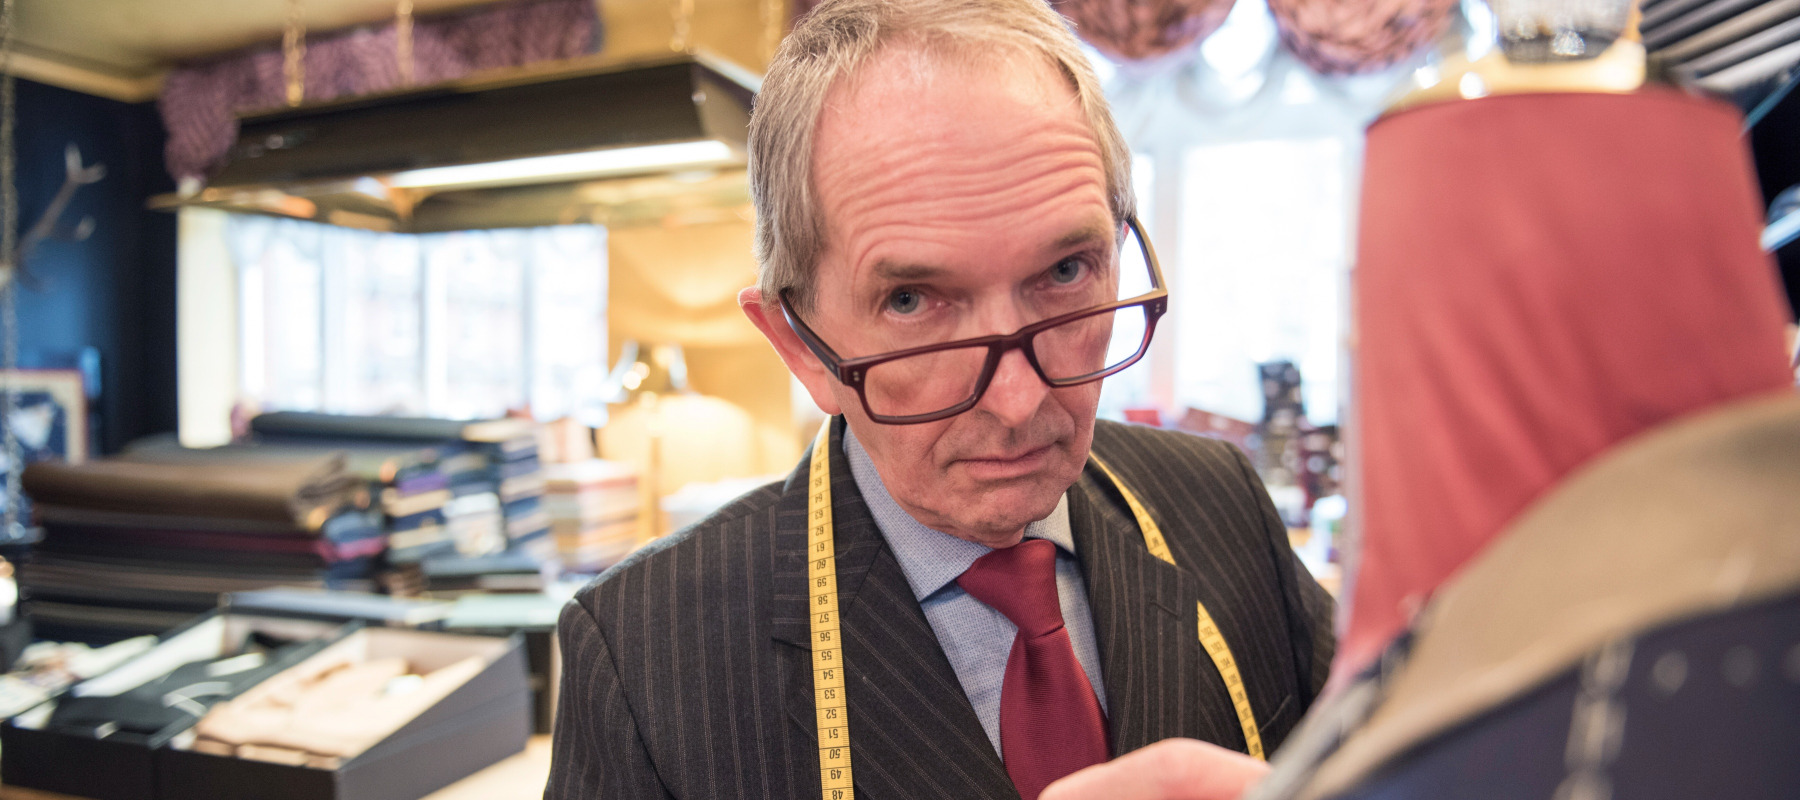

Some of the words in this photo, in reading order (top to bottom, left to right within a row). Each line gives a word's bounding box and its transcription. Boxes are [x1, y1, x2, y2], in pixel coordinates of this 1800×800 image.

[815, 509, 823, 520] 63
[816, 526, 824, 536] 62
[817, 543, 825, 552] 61
[817, 560, 826, 570] 60
[817, 578, 827, 587] 59
[818, 595, 828, 605] 58
[819, 613, 829, 623] 57
[820, 632, 831, 642] 56
[821, 651, 832, 660] 55
[823, 670, 834, 680] 54
[824, 689, 835, 699] 53
[825, 709, 837, 719] 52
[828, 729, 838, 739] 51
[829, 749, 841, 759] 50
[830, 769, 841, 780] 49
[832, 790, 843, 800] 48
